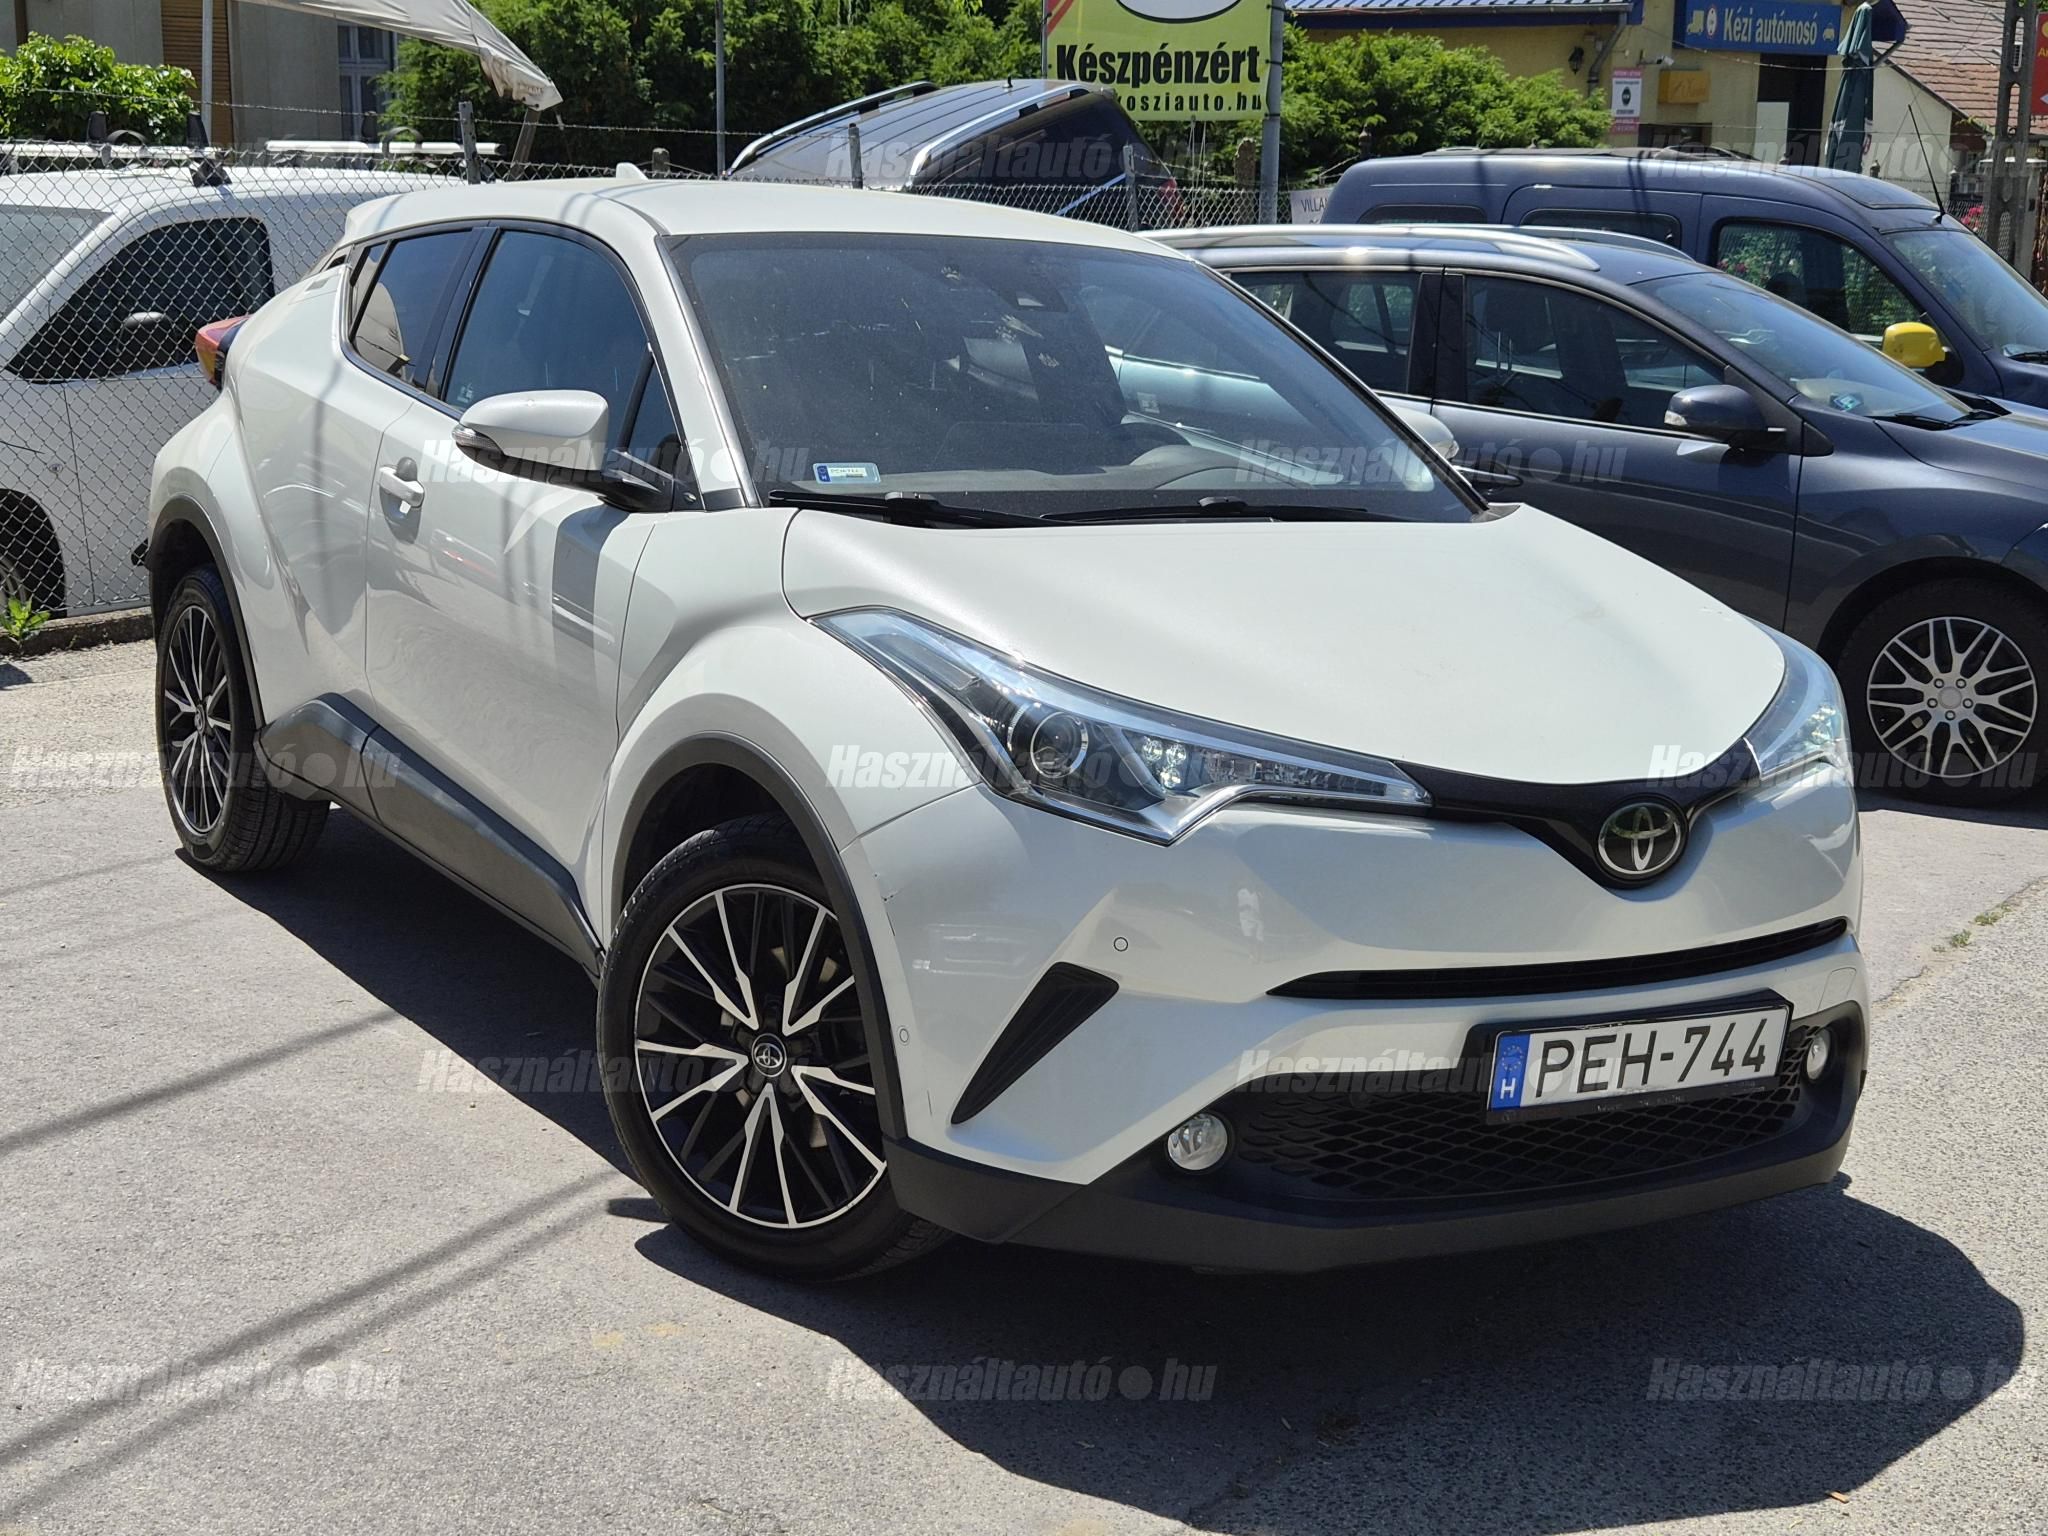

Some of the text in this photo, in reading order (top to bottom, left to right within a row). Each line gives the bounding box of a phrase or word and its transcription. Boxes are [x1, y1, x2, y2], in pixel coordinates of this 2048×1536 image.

[1723, 6, 1818, 46] Kézi autómosó
[1056, 42, 1260, 88] Készpénzért
[1500, 1078, 1517, 1099] H
[1535, 1018, 1768, 1098] PEH-744
